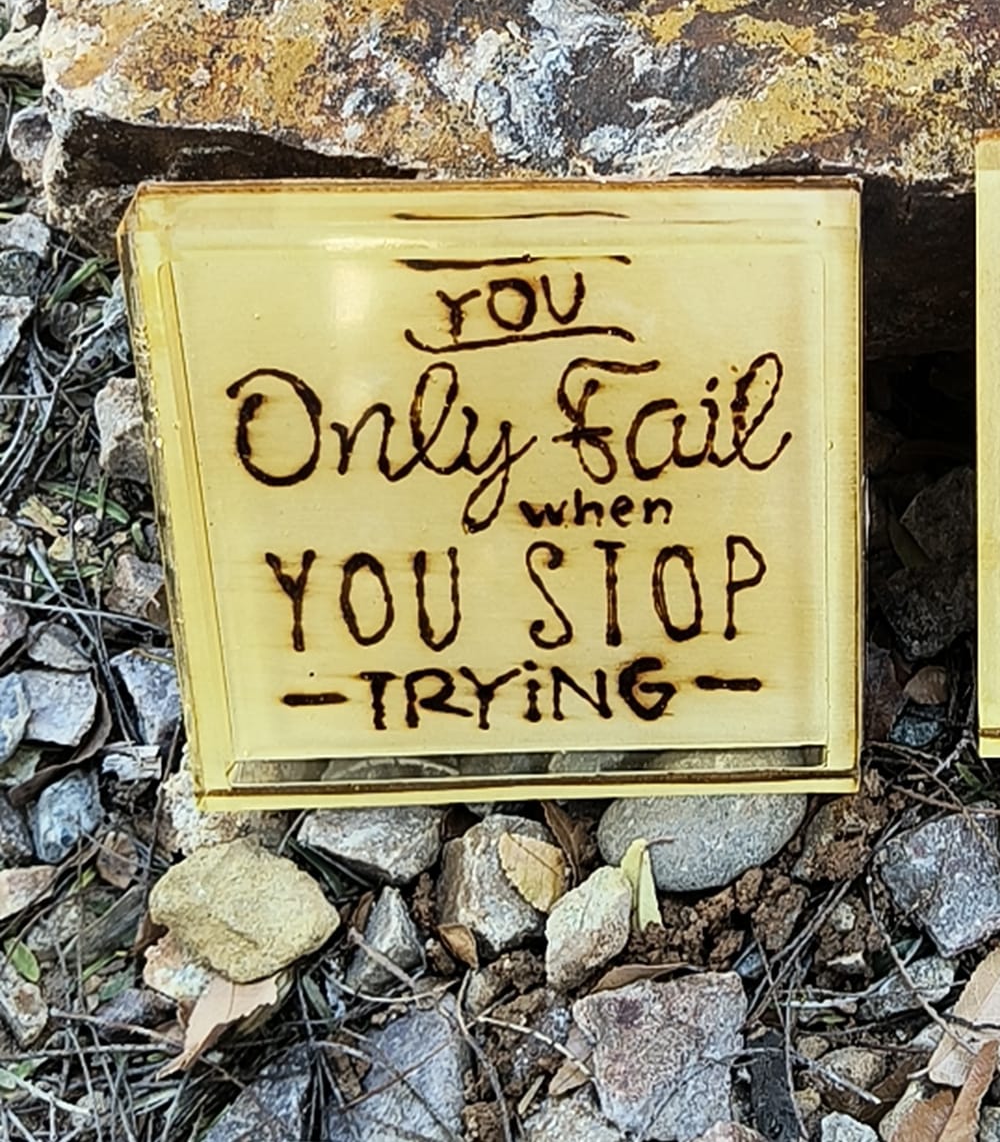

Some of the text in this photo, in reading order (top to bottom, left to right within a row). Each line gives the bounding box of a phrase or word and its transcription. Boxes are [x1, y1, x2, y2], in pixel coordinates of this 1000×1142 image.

[436, 271, 586, 344] YOU
[226, 352, 792, 534] Only Fail
[518, 489, 672, 529] when
[265, 534, 769, 653] YOU STOP
